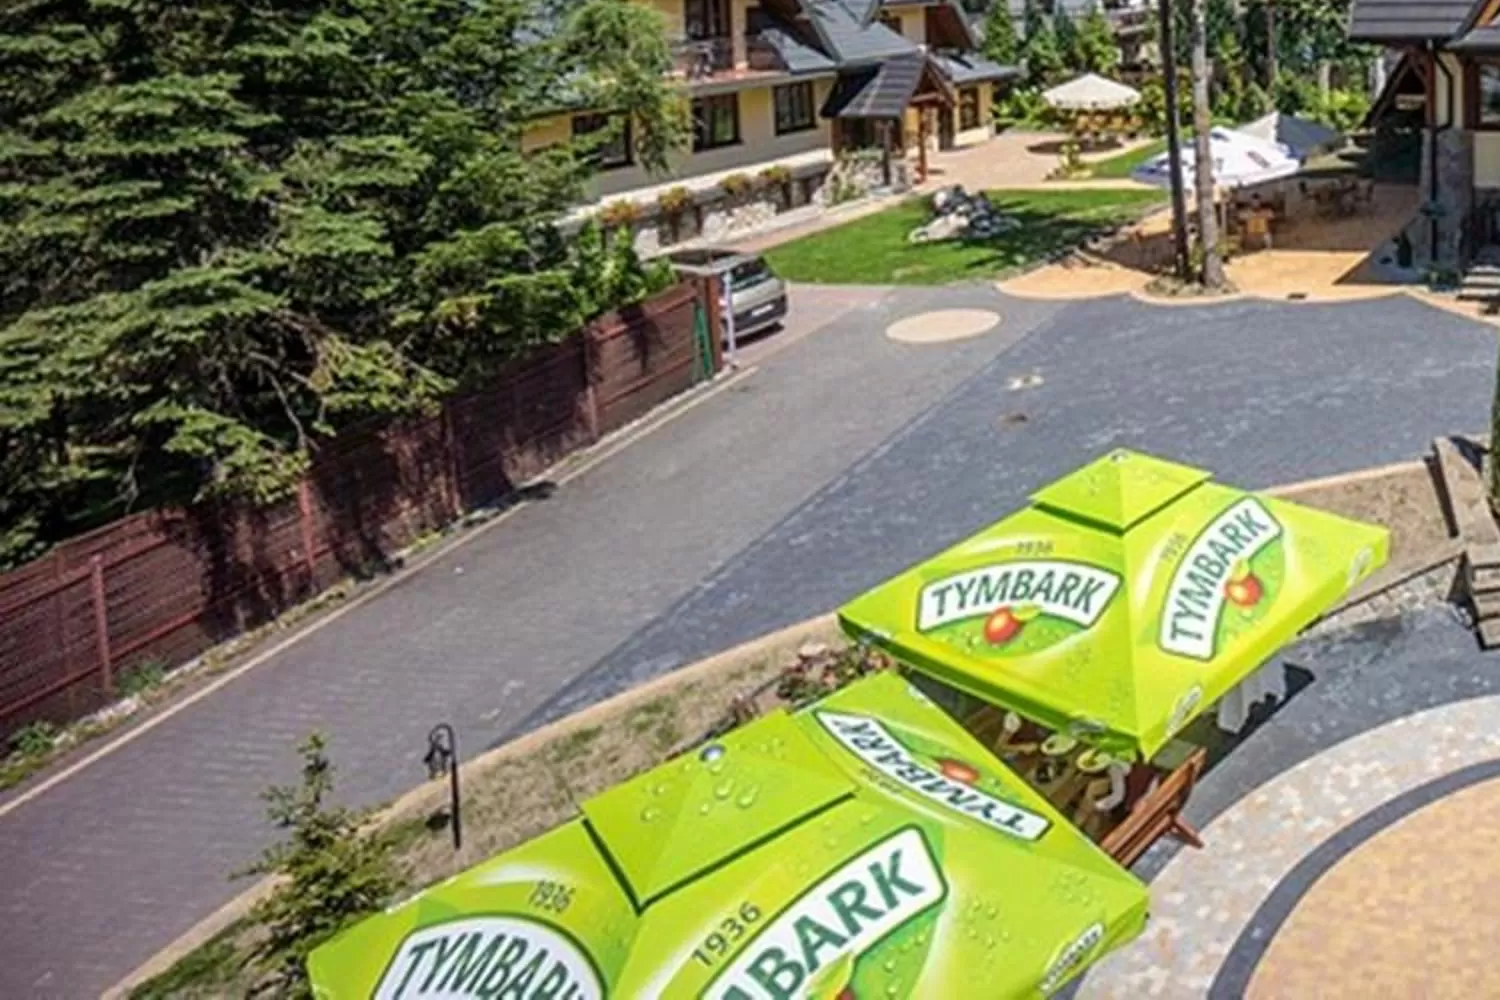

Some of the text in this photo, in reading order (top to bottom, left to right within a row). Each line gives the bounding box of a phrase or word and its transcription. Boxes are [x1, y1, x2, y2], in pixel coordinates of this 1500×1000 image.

[931, 568, 1106, 617] TYMBARK
[1170, 507, 1270, 641] TYMBARK
[832, 719, 1025, 833] TYMBARK
[691, 901, 762, 967] 1936
[720, 850, 926, 1000] BARK
